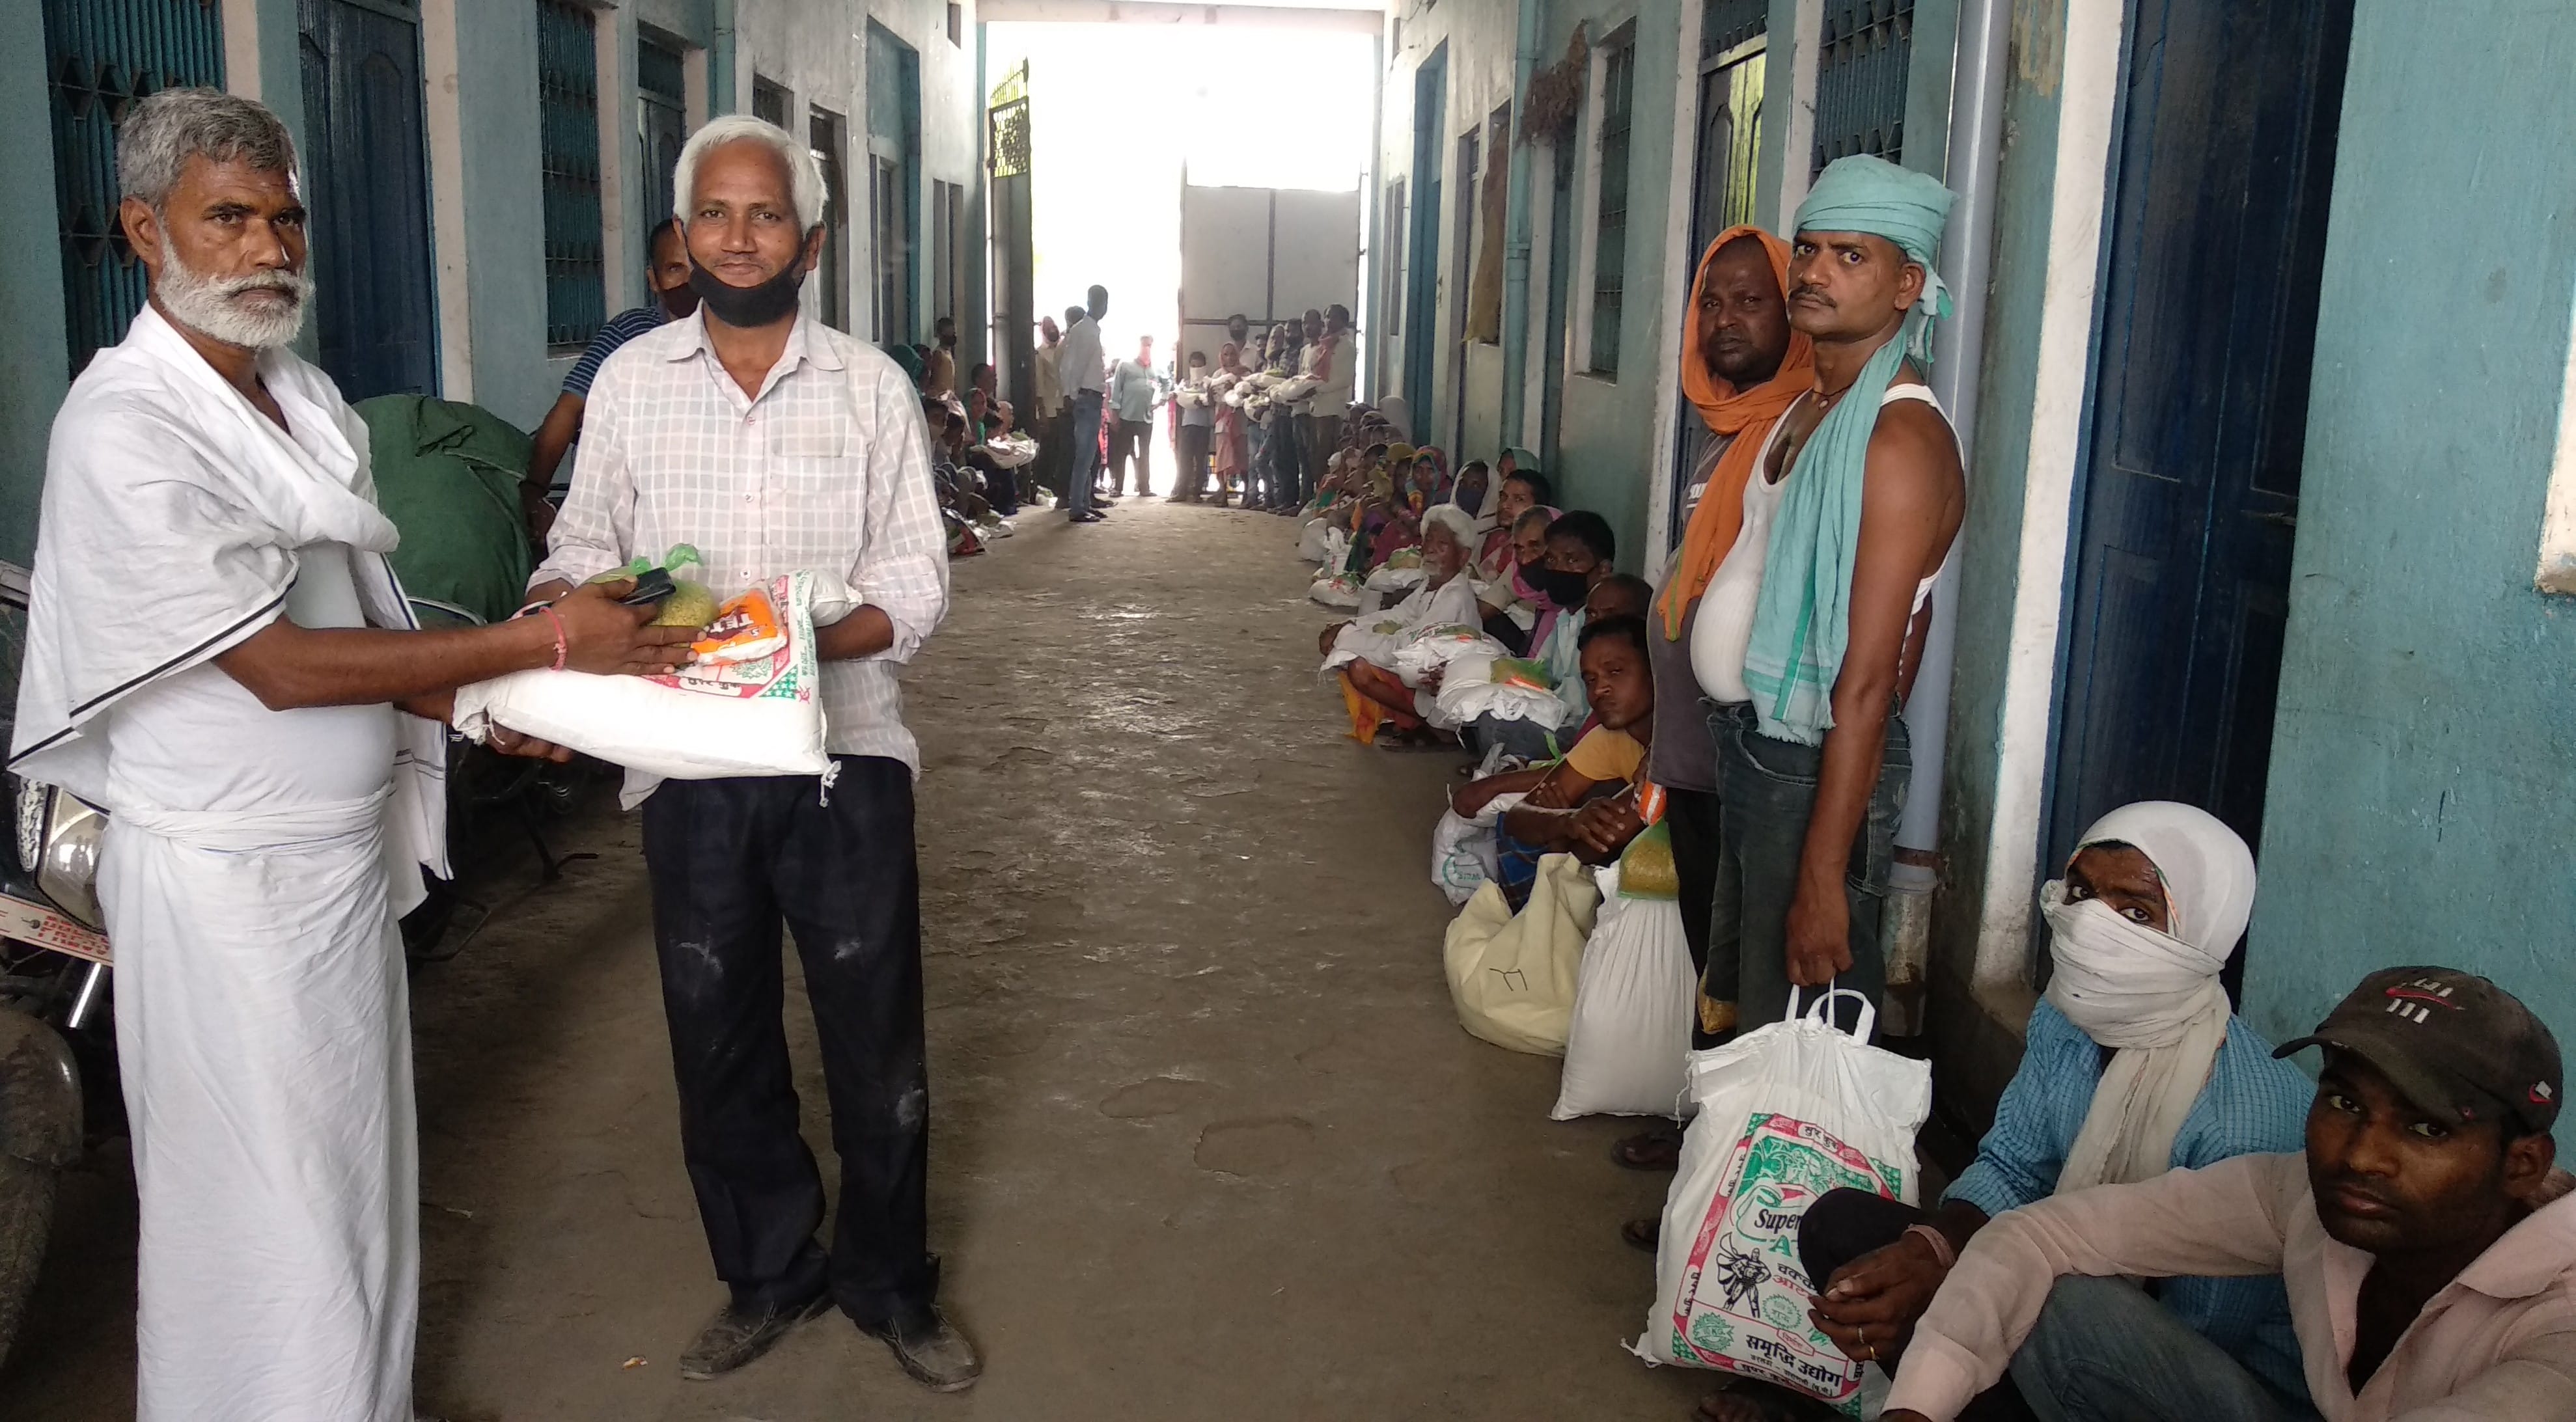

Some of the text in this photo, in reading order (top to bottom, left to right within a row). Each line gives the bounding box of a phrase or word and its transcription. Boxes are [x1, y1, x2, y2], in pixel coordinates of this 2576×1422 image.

[1754, 1209, 1803, 1234] Super
[1746, 1333, 1796, 1368] समृद्धि
[1797, 1358, 1843, 1387] उद्योग
